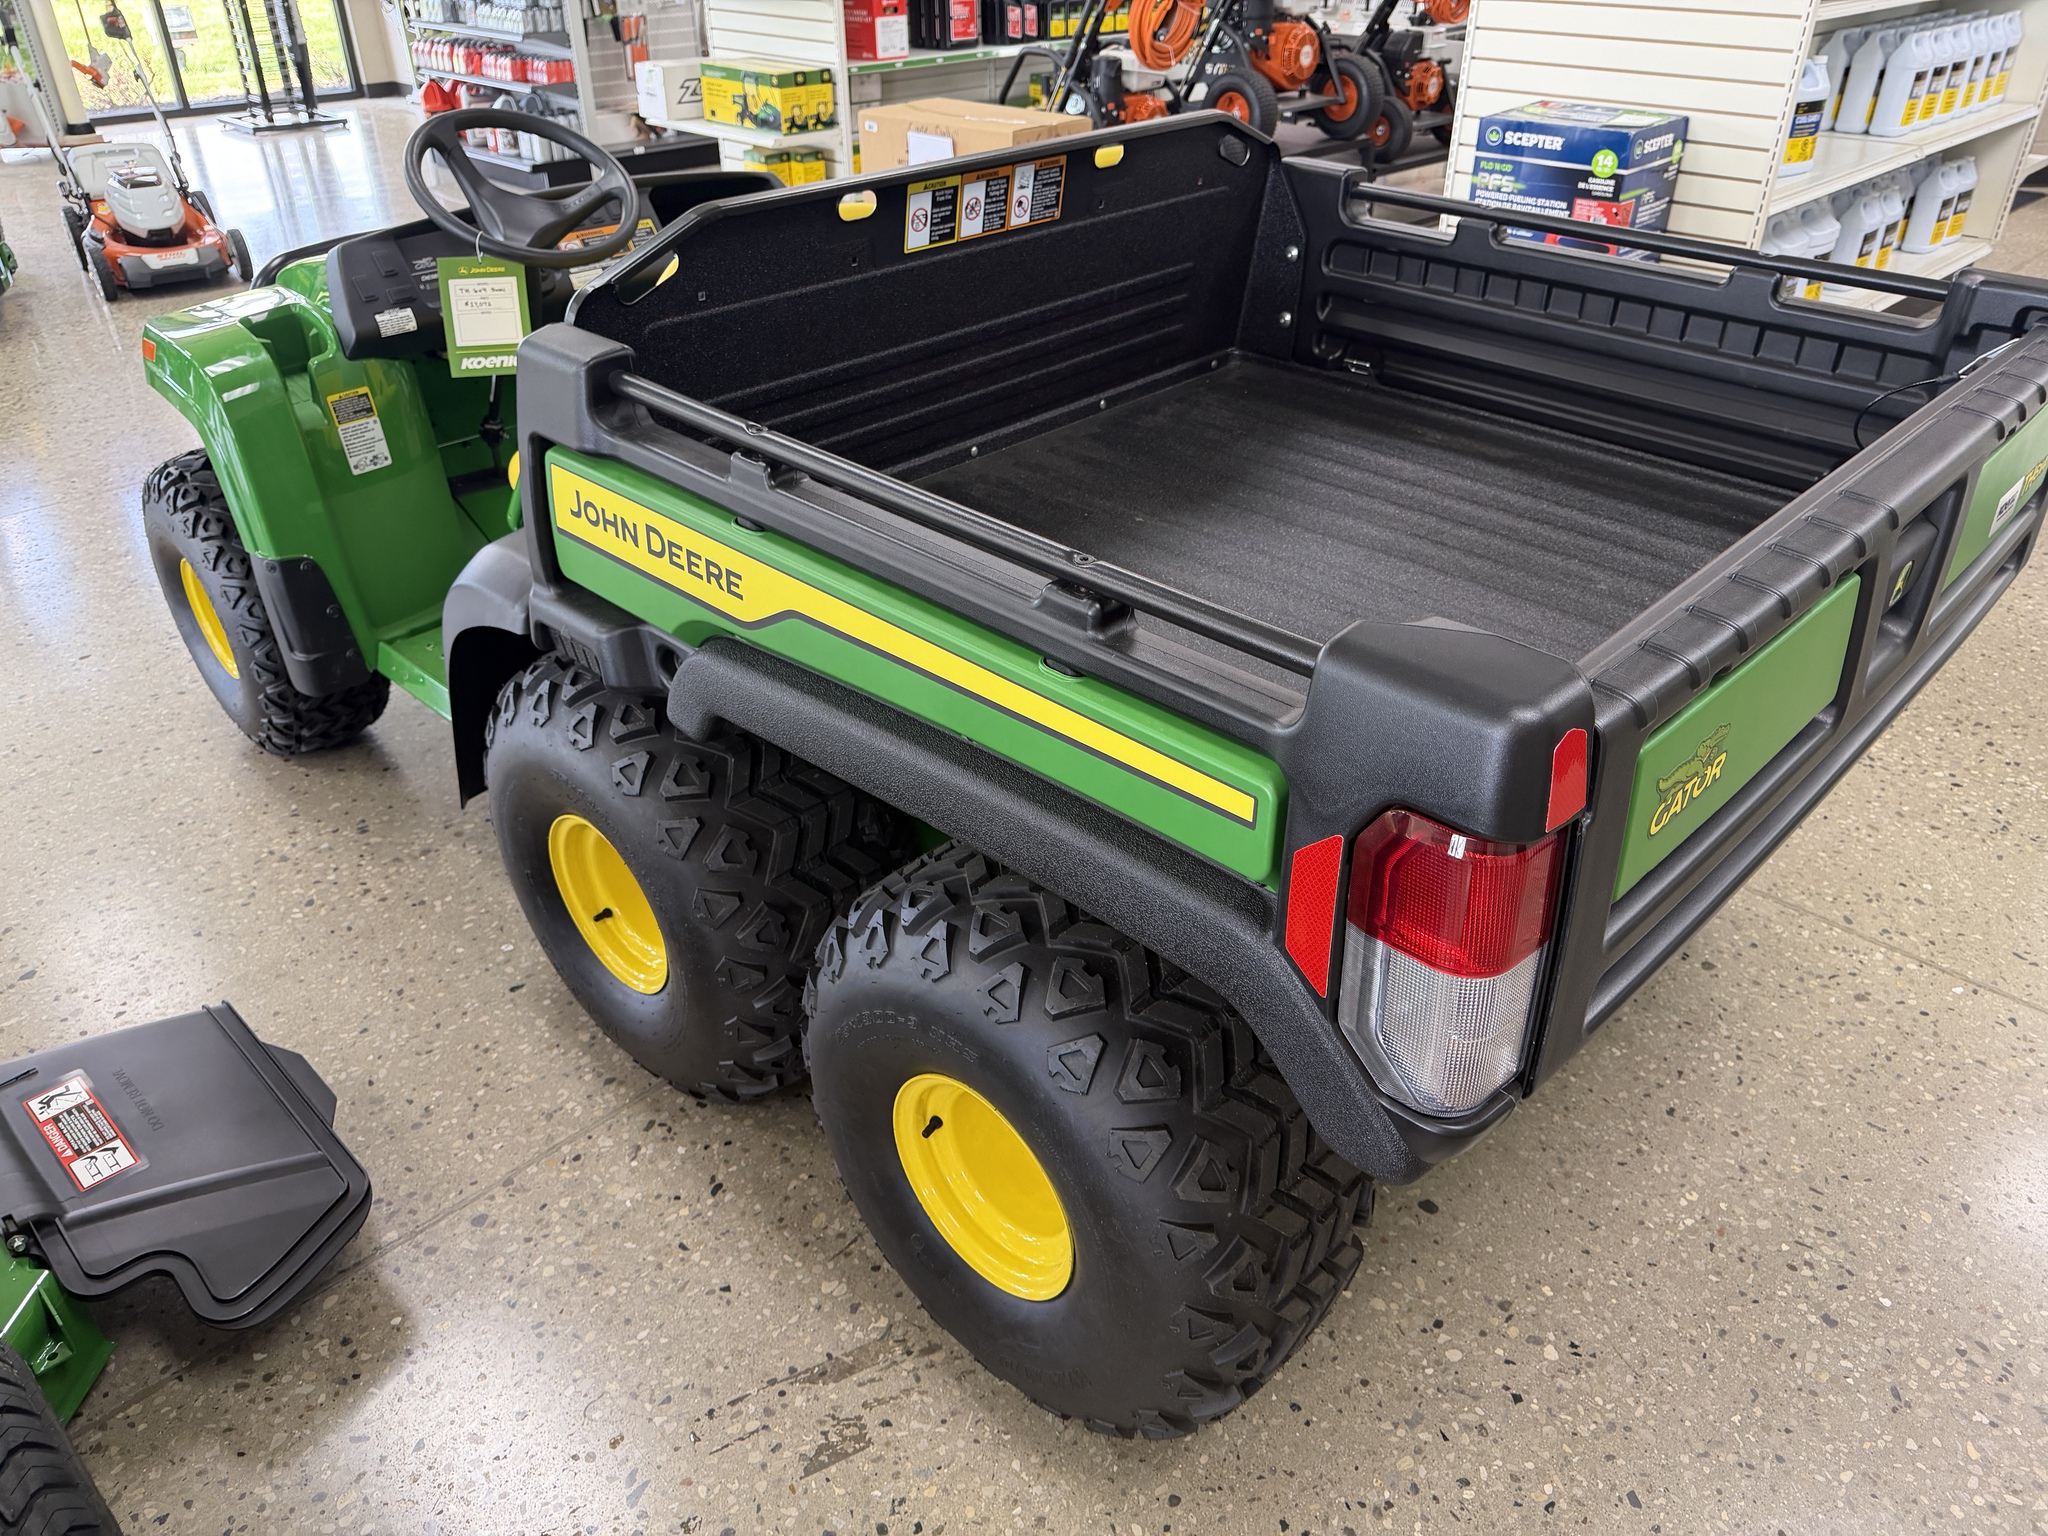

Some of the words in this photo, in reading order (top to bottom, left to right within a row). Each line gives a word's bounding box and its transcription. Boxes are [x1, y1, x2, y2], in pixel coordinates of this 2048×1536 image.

[1504, 131, 1564, 150] SCEPTER
[1644, 134, 1674, 154] SCEPTER
[1598, 154, 1613, 167] 14
[928, 180, 946, 189] CAUTION
[1477, 172, 1516, 192] PFS
[570, 490, 639, 548] JOHN
[646, 523, 744, 600] DEERE
[1648, 751, 1728, 838] GATOR
[43, 1123, 68, 1152] DANGER
